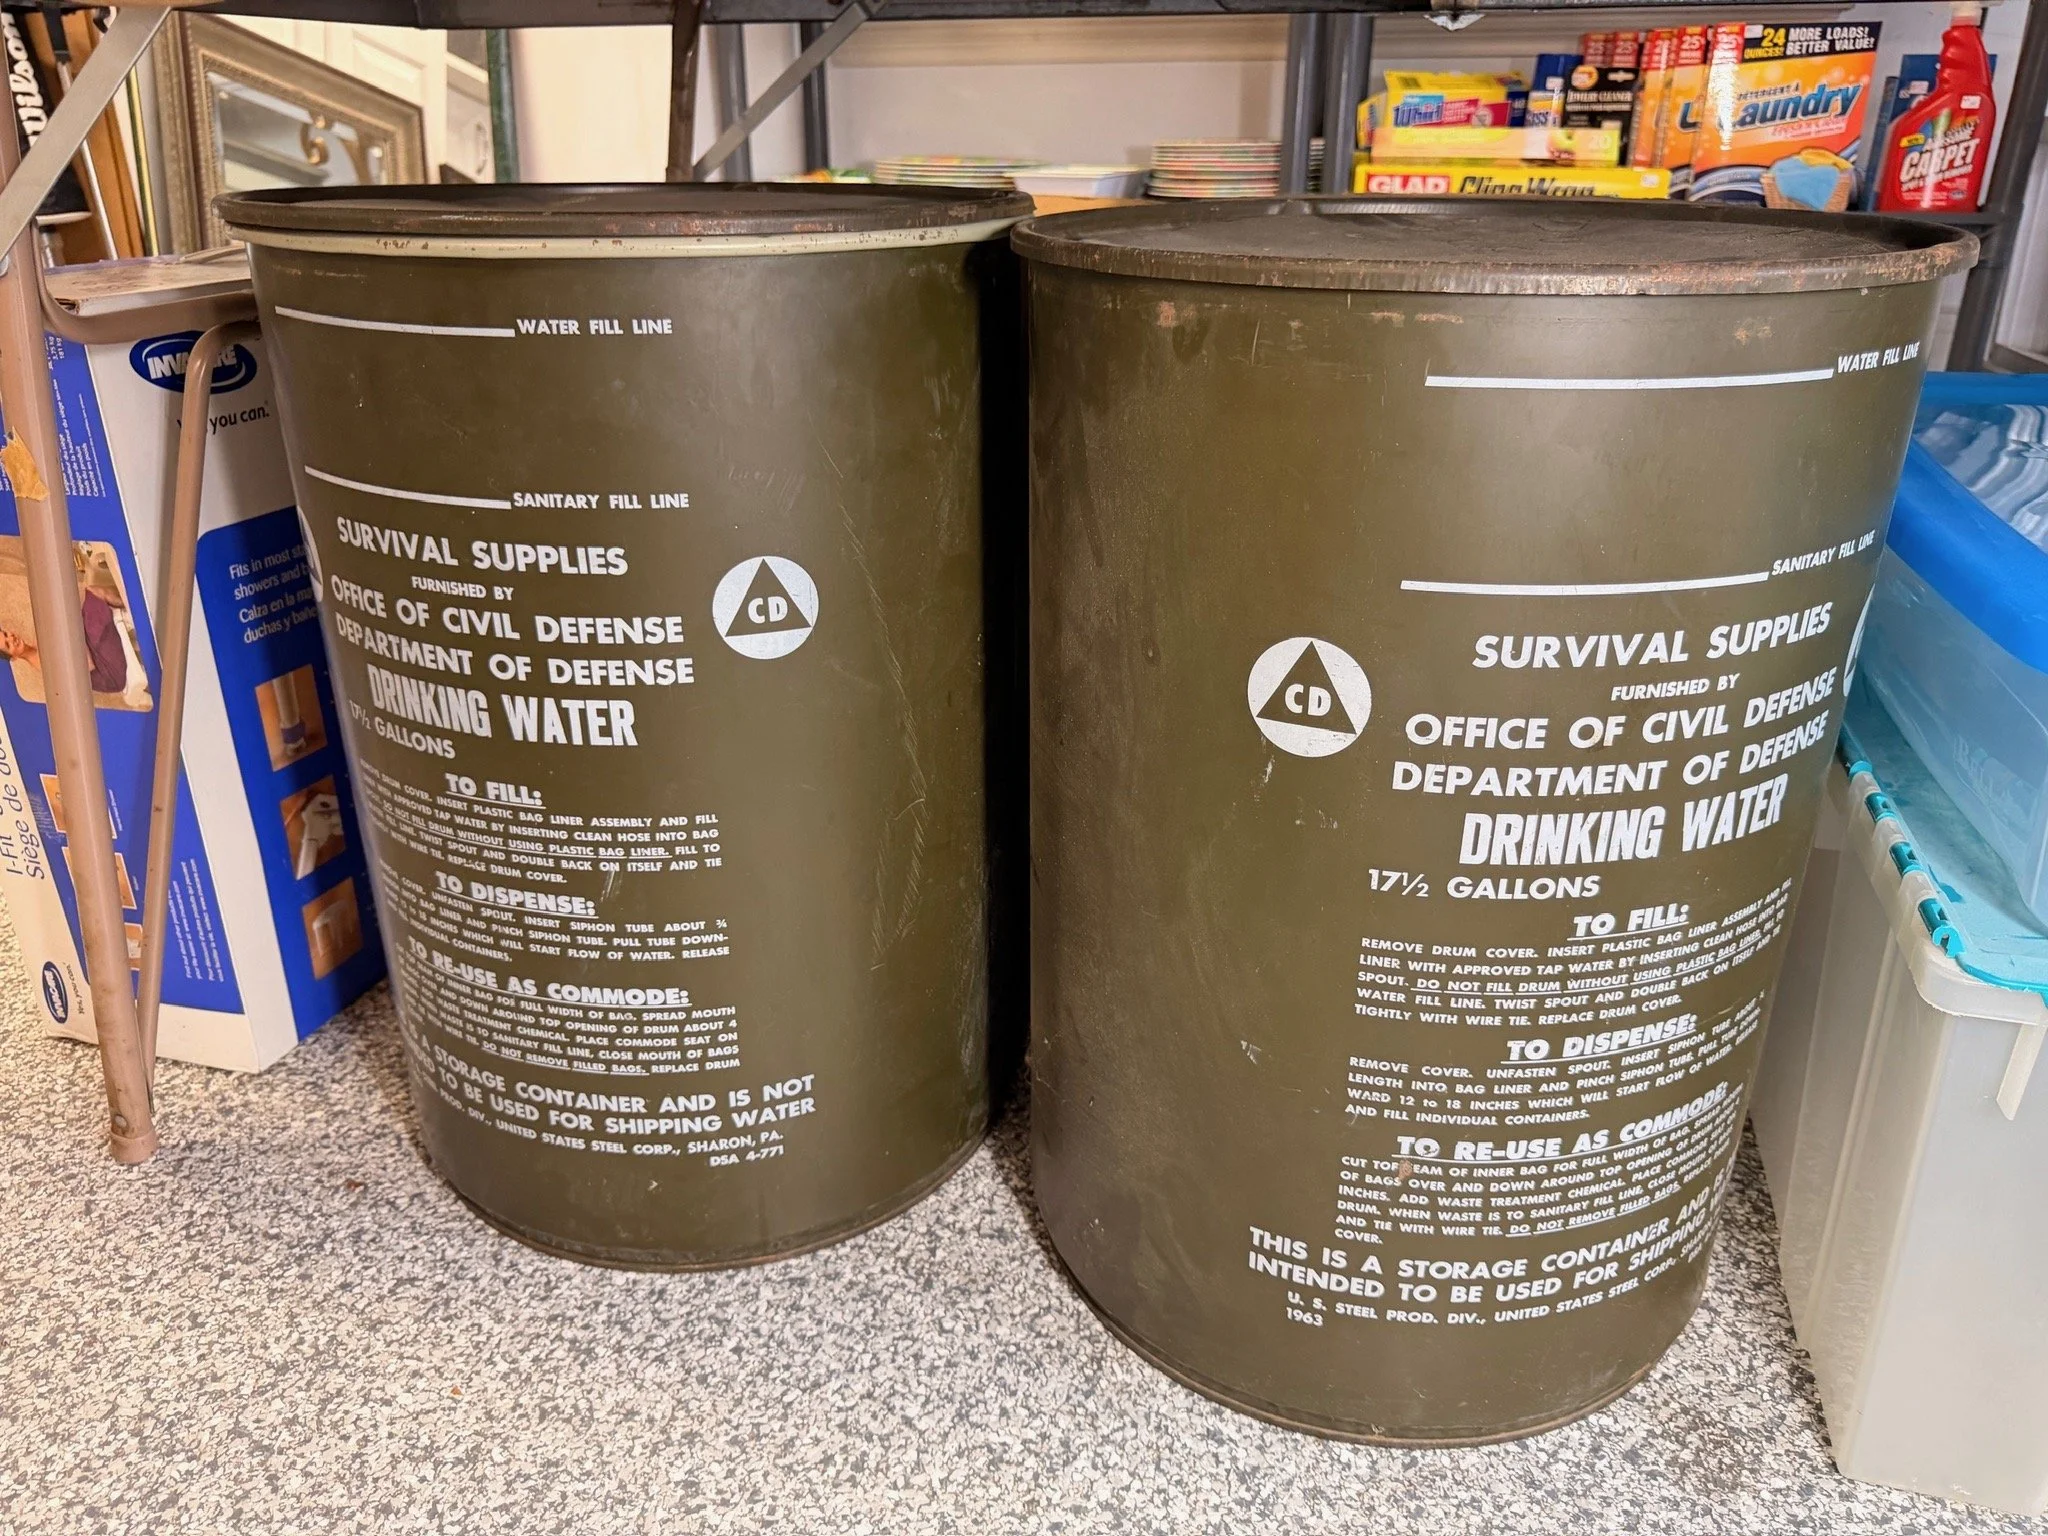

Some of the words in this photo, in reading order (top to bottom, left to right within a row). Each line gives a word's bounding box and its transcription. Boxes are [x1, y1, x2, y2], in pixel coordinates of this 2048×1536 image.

[1761, 28, 1786, 47] 24
[1786, 40, 1830, 55] BETTER
[1835, 37, 1875, 51] VALUE!
[1788, 27, 1822, 41] MORE
[1826, 27, 1869, 40] LOADS!
[1744, 47, 1785, 59] OUNCES!
[1900, 138, 1980, 182] CARPET
[1368, 176, 1449, 193] GLAD
[517, 319, 580, 334] WATER
[589, 319, 623, 334] FILL
[632, 319, 672, 334] LINE
[1838, 352, 1879, 373] WATER
[1882, 347, 1900, 366] FILL
[1903, 341, 1920, 360] LINE
[210, 413, 237, 435] you
[240, 406, 270, 423] can.
[513, 492, 599, 508] SANITARY
[609, 495, 642, 509] FILL
[650, 494, 689, 508] LINE
[337, 517, 458, 565] SURVIVAL
[472, 541, 628, 575] SUPPLIES
[1772, 546, 1836, 575] SANITARY
[1838, 539, 1855, 559] FILL
[1858, 529, 1875, 551] LINE
[229, 563, 249, 580] Fits
[251, 558, 262, 572] in
[264, 549, 291, 568] most
[235, 578, 280, 601] showers
[281, 565, 301, 582] and
[412, 576, 486, 598] FURNISHED
[494, 586, 513, 600] BY
[239, 603, 269, 624] Calza
[270, 597, 285, 611] en
[331, 575, 387, 618] OFFICE
[396, 599, 429, 627] OF
[443, 607, 520, 640] CIVIL
[535, 616, 684, 644] DEFENSE
[748, 596, 788, 623] CD
[244, 619, 283, 643] duchas
[1472, 630, 1688, 668] SURVIVAL
[1706, 602, 1833, 658] SUPPLIES
[335, 612, 472, 675] DEPARTMENT
[489, 654, 531, 681] OF
[548, 658, 694, 685] DEFENSE
[1285, 684, 1331, 716] CD
[1611, 679, 1710, 701] FURNISHED
[1717, 673, 1740, 691] BY
[367, 664, 492, 737] DRINKING
[501, 694, 638, 746] WATER
[1406, 714, 1549, 749] OFFICE
[1569, 716, 1626, 748] OF
[1643, 705, 1728, 743] CIVIL
[1744, 667, 1837, 727] DEFENSE
[374, 718, 456, 758] GALLONS
[1392, 760, 1668, 796] DEPARTMENT
[1683, 750, 1730, 785] OF
[1739, 709, 1828, 774] DEFENSE
[3, 784, 22, 812] de
[445, 773, 477, 796] TO
[486, 780, 543, 805] FILL:
[437, 796, 467, 810] INSERT
[473, 805, 513, 819] PLASTIC
[519, 812, 543, 822] BAG
[550, 815, 583, 825] LINER
[591, 818, 652, 827] ASSEMBLY
[660, 817, 688, 826] AND
[696, 814, 718, 824] FILL
[1459, 806, 1666, 865] DRINKING
[1682, 773, 1788, 851] WATER
[16, 820, 45, 880] Siège
[435, 870, 463, 893] TO
[471, 882, 596, 914] DISPENSE:
[1369, 869, 1428, 897] 17½
[1447, 875, 1600, 899] GALLONS
[1574, 915, 1615, 937] TO
[1627, 903, 1689, 931] FILL:
[408, 936, 427, 960] TO
[432, 951, 498, 988] RE-USE
[508, 976, 537, 996] AS
[547, 983, 690, 1005] COMMODE:
[1355, 1004, 1412, 1020] TIGHTLY
[1420, 1013, 1458, 1024] WITH
[1465, 1016, 1502, 1025] WIRE
[1509, 1016, 1531, 1025] TIE.
[1539, 1011, 1594, 1024] REPLACE
[1599, 1004, 1636, 1019] DRUM
[1642, 994, 1682, 1012] COVER.
[1507, 1040, 1548, 1061] TO
[1563, 1014, 1698, 1058] DISPENSE:
[434, 1045, 506, 1091] STORAGE
[516, 1082, 647, 1113] CONTAINER
[659, 1094, 716, 1113] AND
[729, 1089, 750, 1107] IS
[763, 1074, 814, 1101] NOT
[439, 1067, 458, 1089] TO
[464, 1082, 483, 1103] BE
[490, 1094, 539, 1120] USED
[549, 1110, 594, 1131] FOR
[605, 1115, 722, 1134] SHIPPING
[732, 1098, 815, 1128] WATER
[496, 1119, 537, 1139] UNITED
[542, 1132, 585, 1149] STATES
[591, 1140, 627, 1153] STEEL
[688, 1135, 756, 1153] SHARON,
[760, 1130, 783, 1143] PA.
[1397, 1136, 1440, 1157] TO
[1454, 1140, 1560, 1160] RE-USE
[1572, 1130, 1609, 1152] AS
[1619, 1081, 1728, 1142] COMMODE:
[710, 1154, 739, 1166] DSA
[746, 1145, 783, 1161] 4-771
[1250, 1226, 1307, 1259] THIS
[1323, 1247, 1347, 1268] IS
[1361, 1256, 1382, 1274] A
[1398, 1259, 1528, 1279] STORAGE
[1541, 1217, 1669, 1272] CONTAINER
[1676, 1187, 1710, 1225] AND
[1249, 1251, 1384, 1297] INTENDED
[1399, 1283, 1437, 1302] TO
[1450, 1286, 1483, 1303] BE
[1496, 1278, 1562, 1301] USED
[1573, 1262, 1618, 1289] FOR
[1628, 1208, 1706, 1271] SHIPPING
[1287, 1307, 1323, 1326] 1963
[1288, 1291, 1304, 1305] U.
[1313, 1298, 1326, 1311] S.
[1335, 1302, 1378, 1319] STEEL
[1386, 1310, 1438, 1323] PROD.
[1495, 1306, 1550, 1322] UNITED
[1556, 1291, 1603, 1313] STATES
[1608, 1277, 1639, 1298] STEEL
